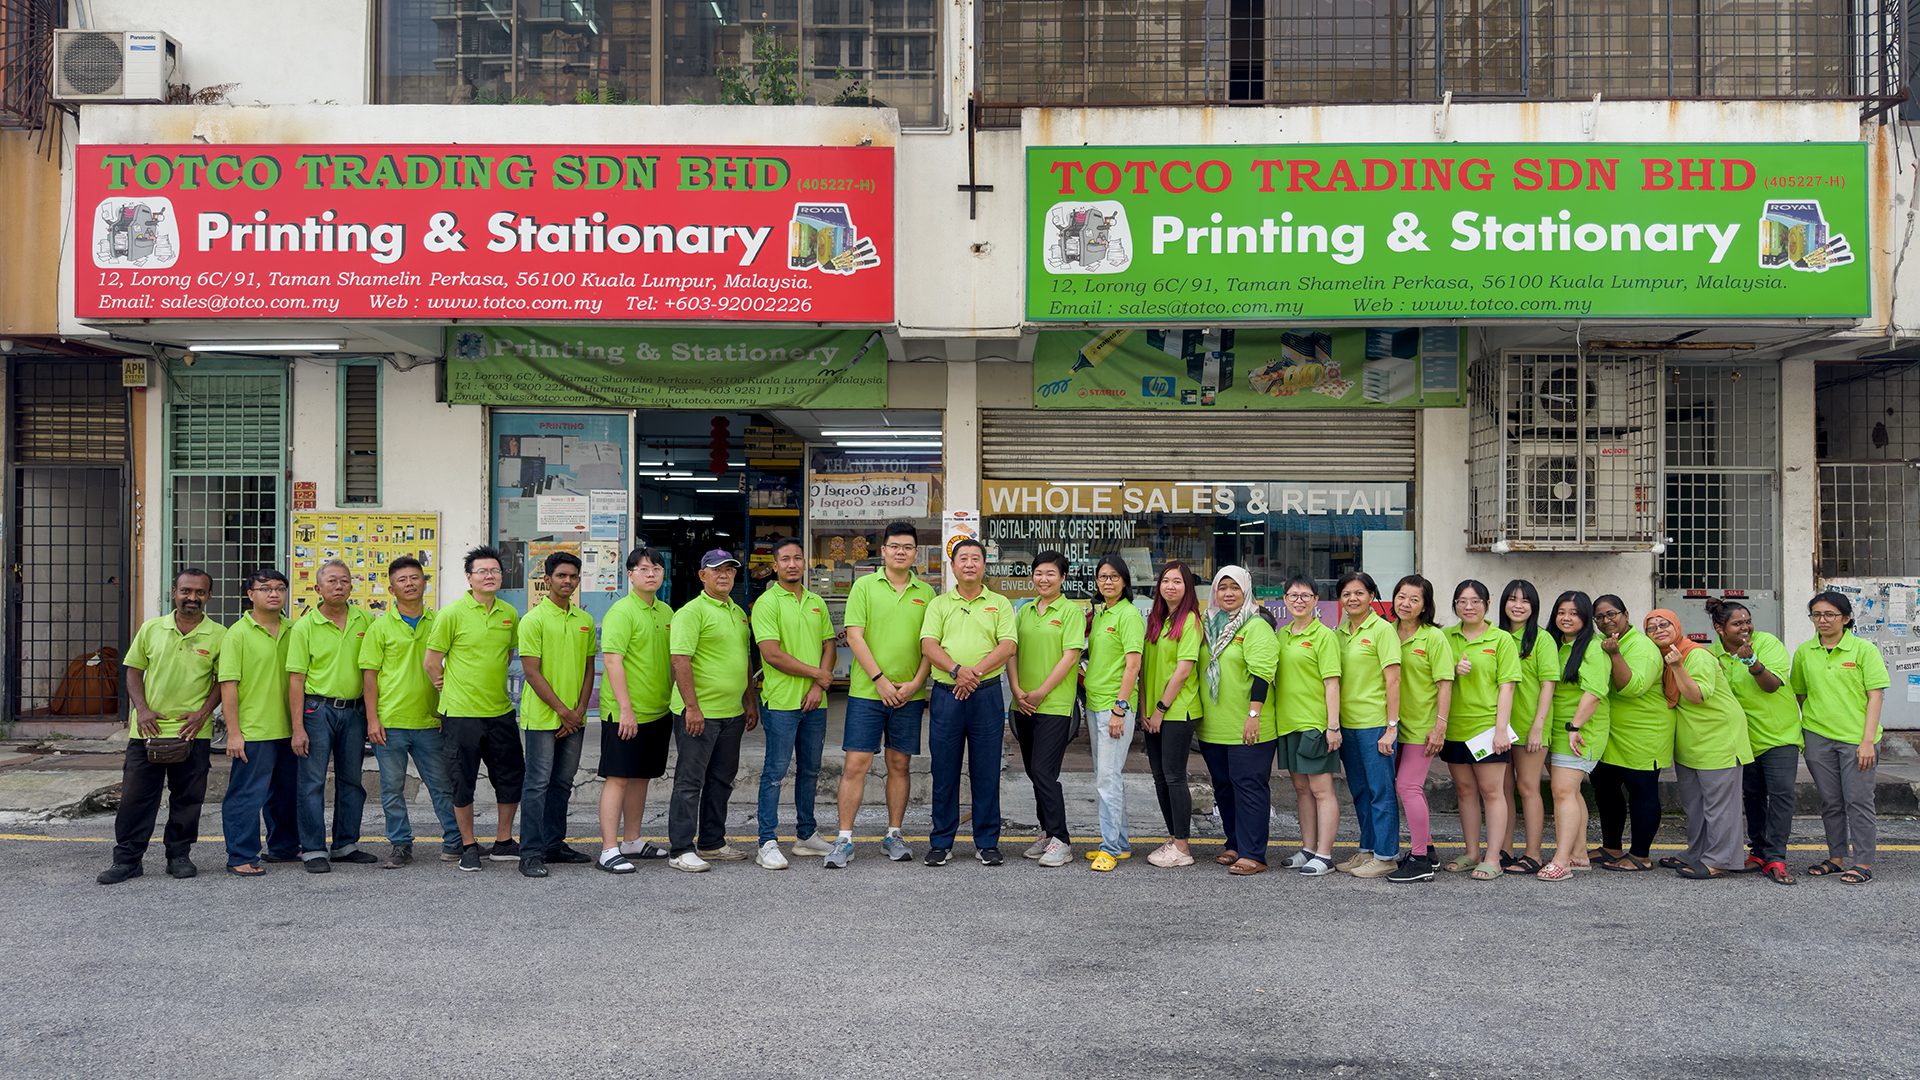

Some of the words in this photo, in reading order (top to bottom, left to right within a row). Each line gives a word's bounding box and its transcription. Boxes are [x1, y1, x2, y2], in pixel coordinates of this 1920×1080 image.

[102, 155, 281, 191] TOTCO
[296, 155, 536, 191] TRADING
[552, 156, 657, 192] SDN
[677, 156, 790, 193] BHD
[797, 179, 876, 194] (405227-H)
[1050, 160, 1233, 194] TOTCO
[1250, 158, 1496, 193] TRADING
[1513, 158, 1620, 192] SDN
[1641, 158, 1757, 192] BHD
[1764, 174, 1846, 191] (405227-H)
[198, 211, 403, 263] Printing
[424, 212, 466, 253] &
[486, 211, 771, 267] Stationary
[1152, 212, 1365, 264] Printing
[1386, 212, 1431, 253] &
[1450, 210, 1741, 264] Stationary
[98, 272, 124, 289] 12,
[130, 272, 192, 290] Lorong
[197, 272, 261, 289] 6C/91,
[268, 272, 331, 286] Taman
[337, 272, 422, 286] Shamelin
[429, 272, 509, 290] Perkasa,
[515, 273, 576, 287] 56100
[580, 273, 636, 288] Kuala
[642, 274, 717, 292] Lumpur,
[724, 274, 812, 293] Malaysia.
[1053, 279, 1077, 296] 12,
[1084, 279, 1147, 297] Lorong
[1153, 278, 1218, 294] 6C/91,
[1227, 278, 1290, 292] Taman
[1298, 277, 1386, 292] Shamelin
[1392, 276, 1475, 294] Perkasa,
[1482, 275, 1543, 290] 56100
[1549, 275, 1604, 289] Kuala
[1610, 276, 1687, 293] Lumpur,
[1695, 275, 1787, 293] Malaysia.
[98, 295, 155, 309] Email:
[160, 293, 340, 313] sales@totco.com.my
[369, 295, 409, 309] Web
[427, 297, 603, 314] www.totco.com.my
[626, 297, 658, 311] Tel:
[664, 297, 812, 312] +603-92002226
[1049, 300, 1102, 315] Email
[1118, 300, 1304, 317] sales@totco.com.my
[1353, 298, 1394, 312] Web
[1410, 298, 1592, 316] www.totco.com.my
[493, 338, 626, 365] Printing
[636, 342, 661, 361] &
[671, 343, 839, 366] Stationery
[125, 363, 145, 375] APH
[455, 372, 472, 382] 12,
[474, 372, 513, 382] Lorong
[559, 374, 598, 383] Taman
[602, 374, 654, 384] Shamelin
[656, 376, 704, 386] Perkasa,
[709, 376, 745, 385] 56100
[747, 376, 781, 385] Kuala
[784, 376, 829, 387] Lumpur,
[480, 383, 509, 391] +603
[513, 383, 541, 391] 9200
[584, 386, 630, 395] Hunting
[631, 386, 654, 394] Line
[667, 386, 689, 394] Fax
[702, 386, 731, 394] +603
[735, 386, 762, 394] 9281
[767, 386, 795, 394] 1113
[454, 394, 486, 402] Email
[613, 396, 637, 404] Web
[539, 422, 585, 430] PRINTING
[824, 458, 876, 473] THANK
[880, 458, 910, 473] YOU
[988, 487, 1113, 514] WHOLE
[1123, 487, 1235, 515] SALES
[1246, 488, 1270, 515] &
[1281, 488, 1404, 516] RETAIL
[989, 519, 1027, 539] DIGITAL
[1028, 519, 1057, 539] PRINT
[1058, 519, 1067, 539] &
[1068, 519, 1106, 539] OFFSET
[1107, 519, 1137, 539] PRINT
[989, 564, 1014, 576] NAME
[1014, 564, 1033, 576] CAR
